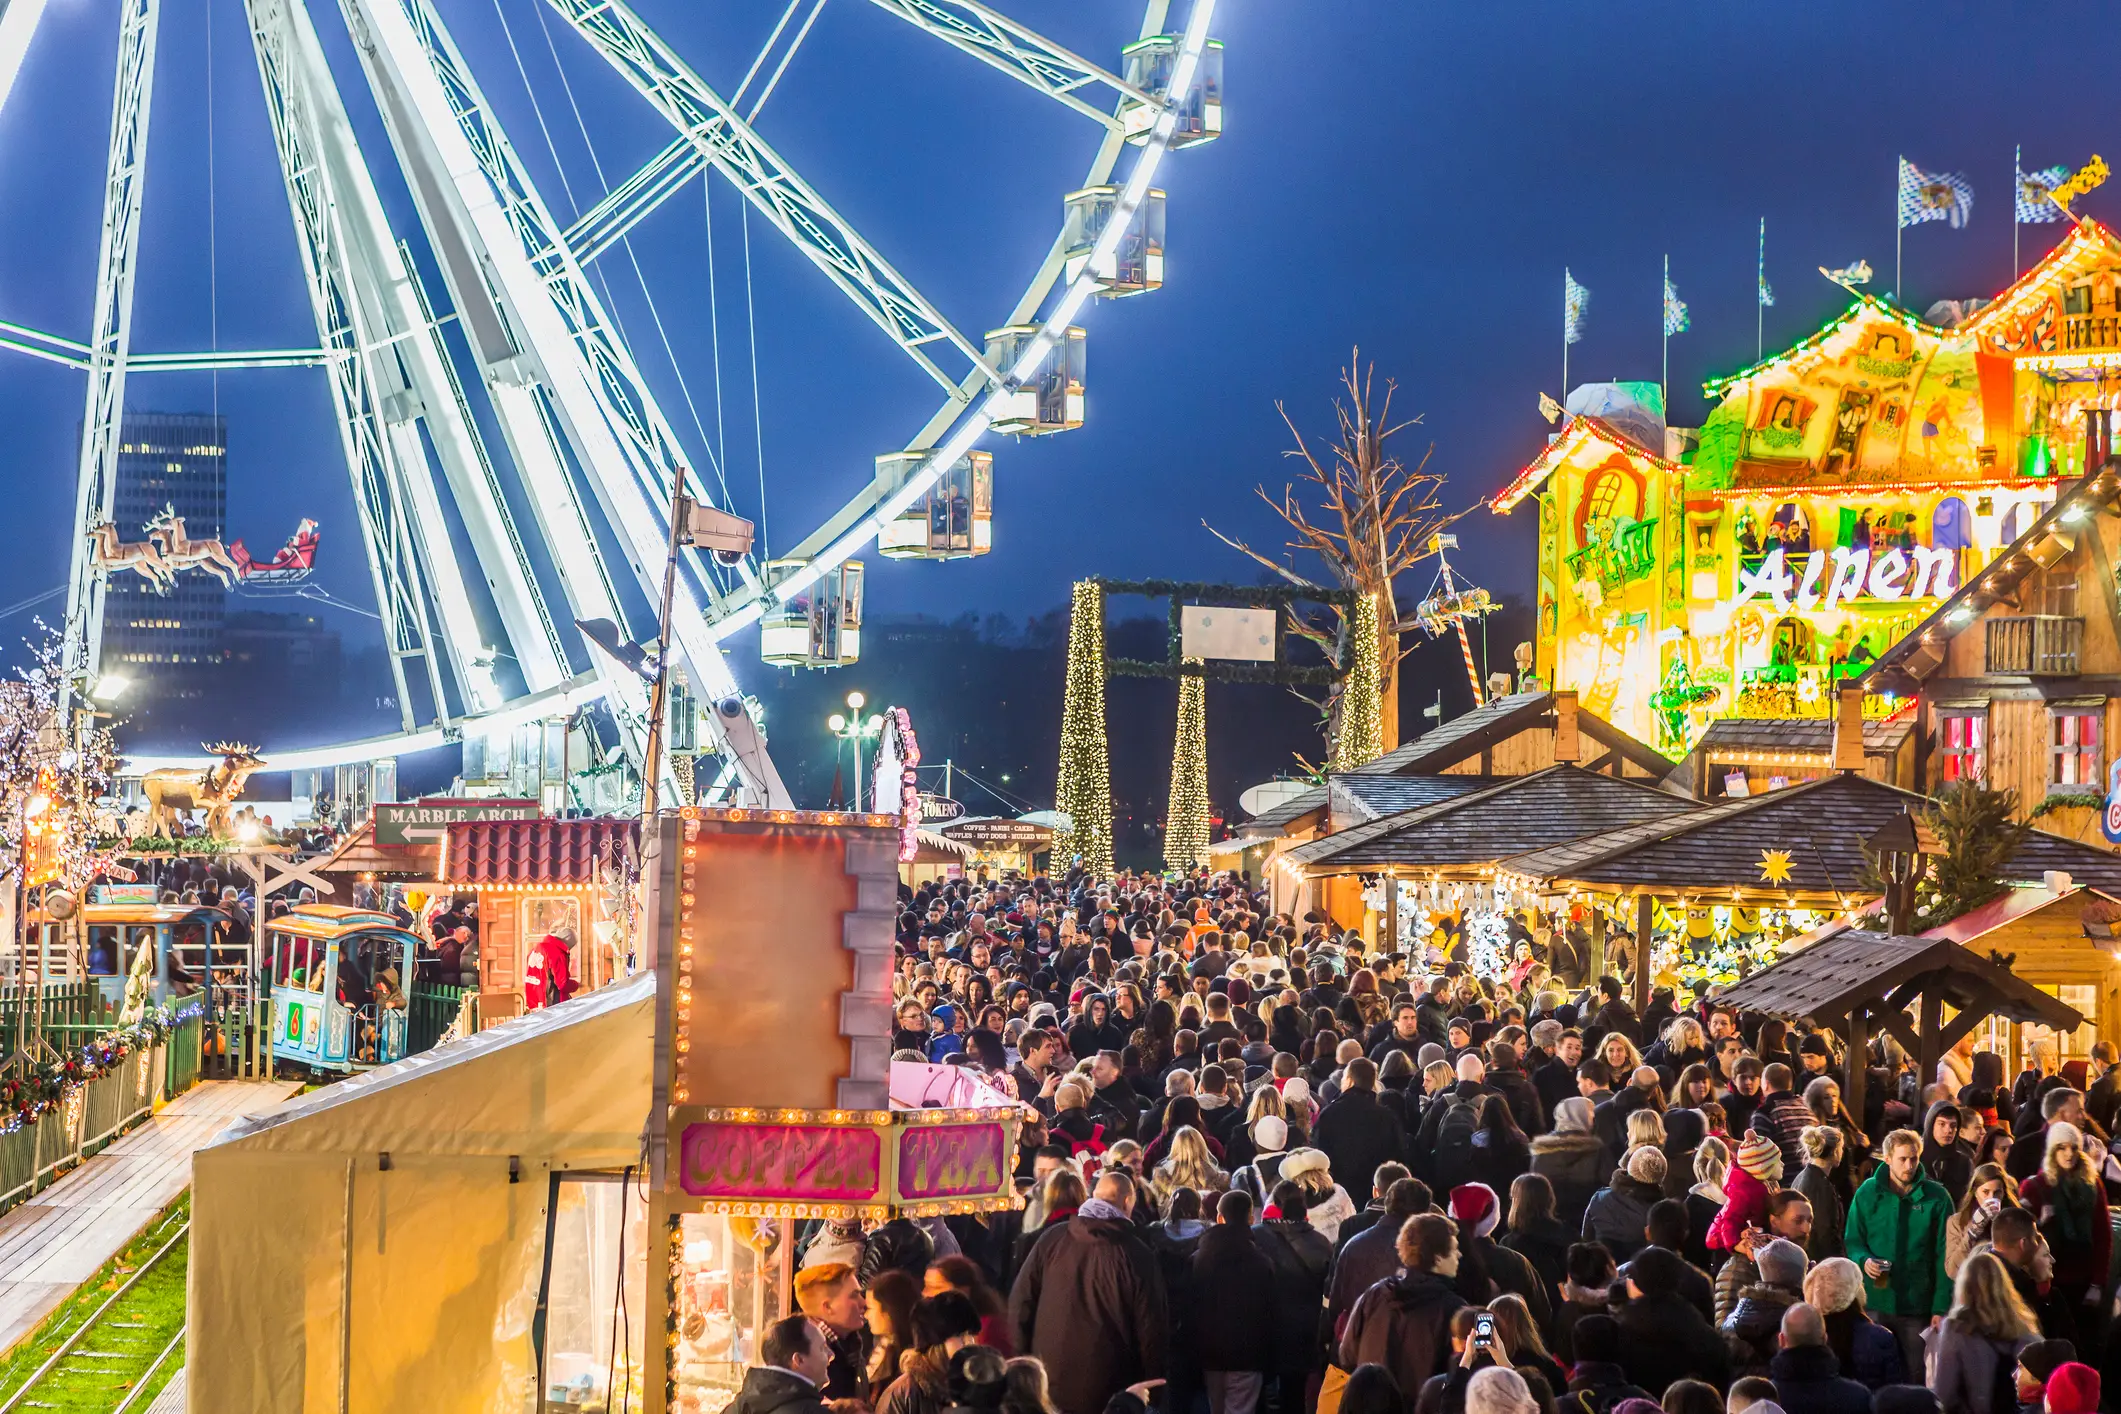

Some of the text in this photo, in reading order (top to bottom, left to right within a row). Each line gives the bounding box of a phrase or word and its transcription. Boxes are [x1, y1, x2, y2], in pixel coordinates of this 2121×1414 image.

[1716, 546, 1956, 614] Alpen
[389, 808, 526, 823] MARBLE ARCH
[922, 802, 957, 817] TOKENS
[990, 824, 1010, 832] PANINI
[291, 1008, 299, 1036] 6
[688, 1130, 1003, 1191] COFFEE TEA
